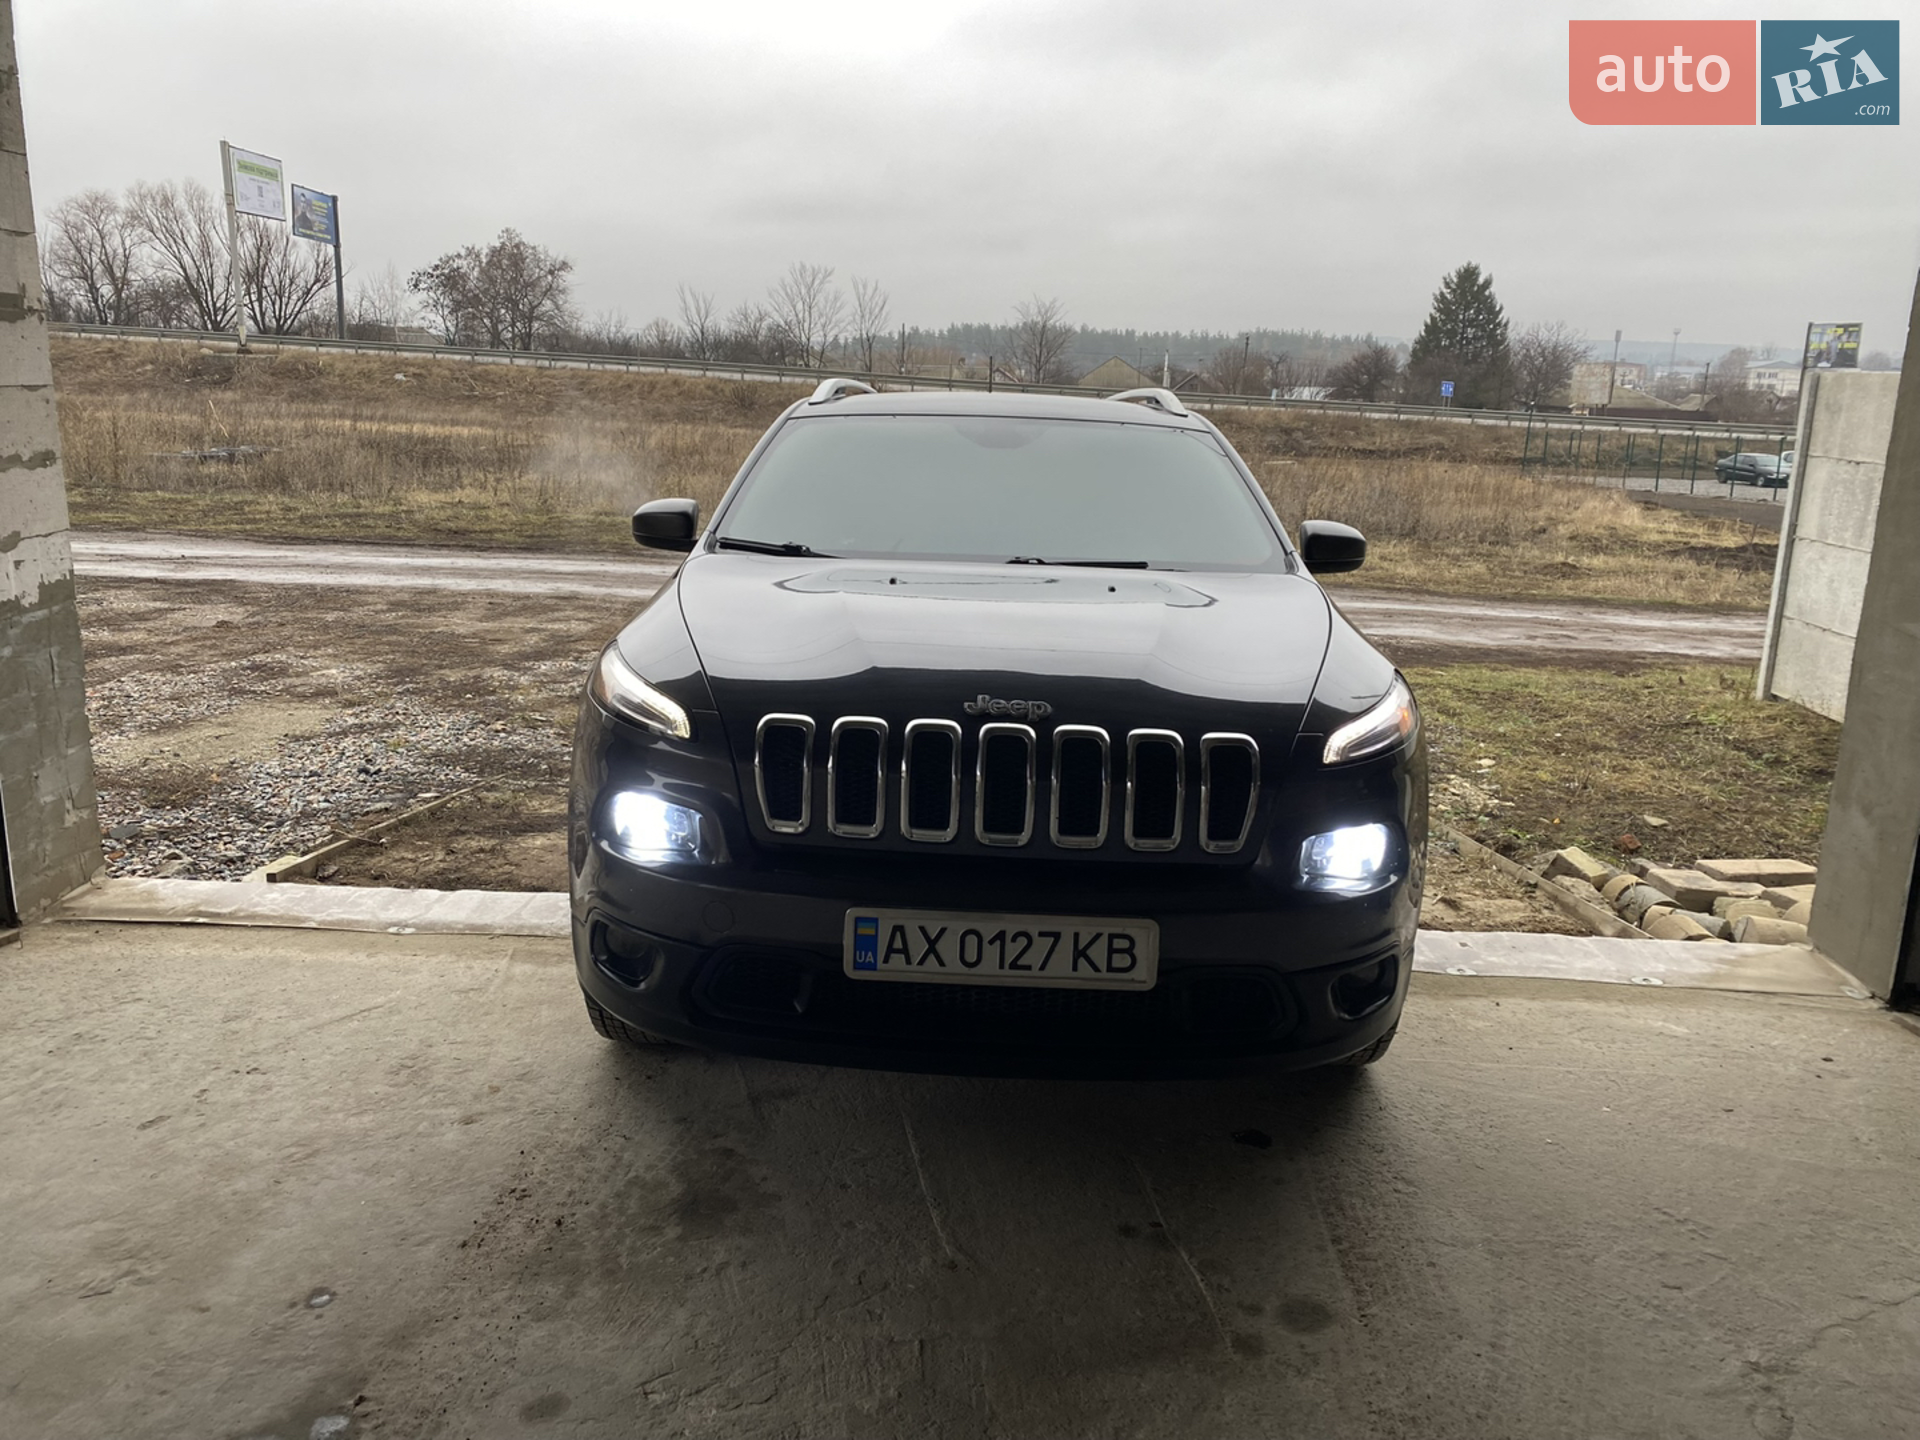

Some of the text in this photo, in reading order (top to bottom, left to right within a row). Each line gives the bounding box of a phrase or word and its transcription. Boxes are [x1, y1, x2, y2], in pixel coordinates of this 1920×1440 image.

[963, 694, 1053, 721] Jeep
[856, 951, 875, 963] UA
[882, 924, 1138, 973] AX 0127 KB
